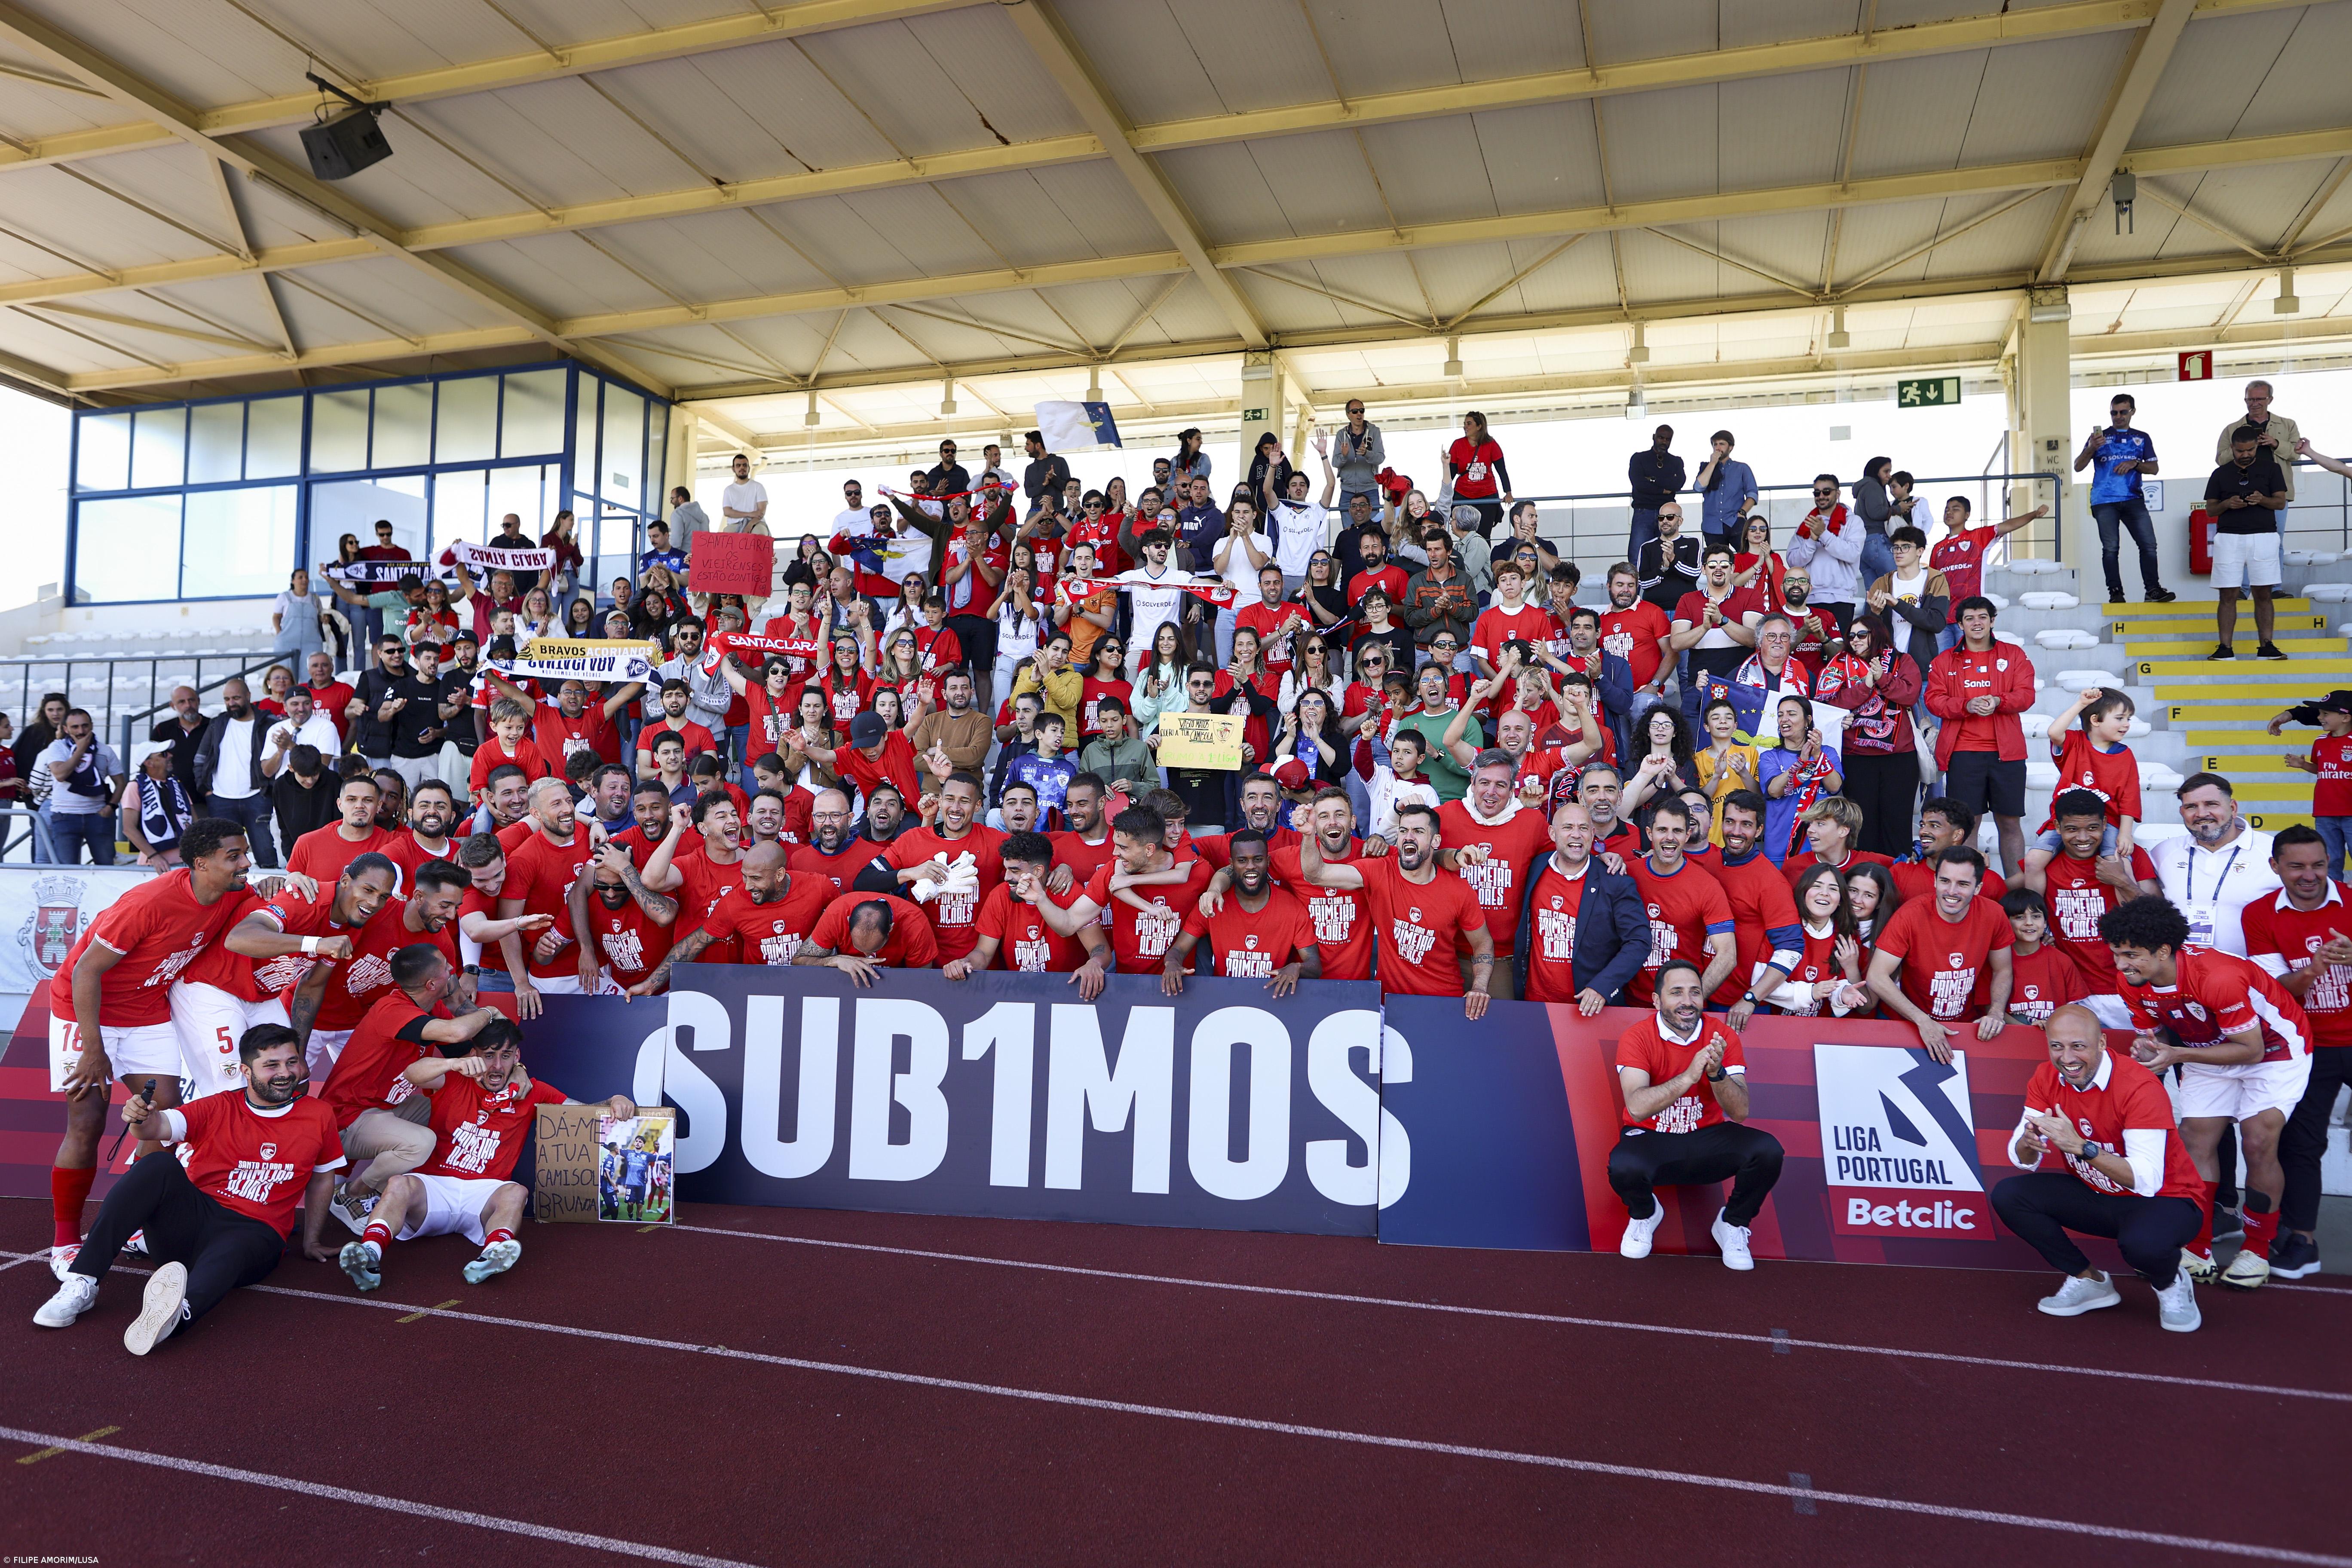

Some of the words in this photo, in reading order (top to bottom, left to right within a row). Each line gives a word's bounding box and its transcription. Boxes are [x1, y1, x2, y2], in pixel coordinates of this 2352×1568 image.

[2047, 456, 2059, 464] WC
[698, 535, 733, 550] SANTA
[739, 538, 770, 554] CLARA
[726, 551, 738, 560] OS
[702, 559, 763, 571] VIEIRENSES
[697, 570, 726, 581] ESTÃO
[728, 573, 767, 583] CONTIGO
[2115, 623, 2125, 633] H
[2314, 619, 2323, 628] H
[728, 635, 818, 651] SANTACLARA
[1603, 637, 1633, 653] PRIMEIRA
[540, 645, 585, 655] BRAVOS
[1268, 647, 1291, 662] AÇORES
[2141, 664, 2150, 674] G
[1964, 679, 1991, 688] Santa
[832, 695, 860, 708] PRIMEIRA
[835, 707, 856, 719] AÇORES
[2172, 708, 2180, 718] F
[1196, 720, 1209, 728] MATOS
[1190, 730, 1213, 740] CAMISOLA
[1165, 753, 1194, 761] RUMO
[1218, 752, 1237, 763] LIGA
[2208, 758, 2217, 769] E
[2252, 816, 2263, 828] D
[1502, 859, 1508, 869] NA
[1460, 865, 1512, 888] PRIMEIRA
[2057, 889, 2071, 898] SANTA
[2072, 888, 2090, 898] CLARA
[2092, 889, 2100, 897] NA
[1309, 903, 1356, 921] PRIMEIRA
[2055, 896, 2105, 917] PRIMEIRA
[940, 904, 973, 924] AÇORES
[1539, 908, 1552, 918] SANTA
[1553, 910, 1568, 920] CLARA
[1136, 919, 1181, 936] PRIMEIRA
[1410, 924, 1425, 935] CLARA
[1650, 920, 1666, 930] CLARA
[2060, 917, 2098, 939] AÇORES
[615, 931, 629, 941] CLARA
[1314, 922, 1351, 941] AÇORES
[603, 936, 643, 957] PRIMEIRA
[761, 937, 777, 946] SANTA
[777, 935, 792, 943] CLARA
[1139, 935, 1174, 956] AÇORES
[363, 953, 381, 965] SANTA
[1228, 950, 1245, 959] SANTA
[1246, 952, 1263, 960] CLARA
[1226, 959, 1273, 978] PRIMEIRA
[2289, 957, 2311, 968] SANTA
[1935, 971, 1951, 980] SANTA
[1952, 969, 1967, 979] CLARA
[1929, 974, 1975, 996] PRIMEIRA
[2316, 983, 2332, 992] PELOS
[2010, 1003, 2025, 1012] SANTA
[2026, 1001, 2045, 1011] CLARA
[2046, 1001, 2054, 1010] NA
[217, 1026, 232, 1054] 5
[632, 989, 1413, 1210] SUB1MOS
[460, 1121, 477, 1133] SANTA
[491, 1130, 500, 1139] NA
[540, 1112, 605, 1144] DÁ-ME
[451, 1127, 500, 1160] PRIMEIRA
[1834, 1126, 1882, 1152] LIGA
[538, 1144, 548, 1163] A
[552, 1143, 590, 1162] TUA
[2103, 1142, 2115, 1152] NA
[238, 1161, 260, 1170] SANTA
[445, 1145, 488, 1174] AÇORES
[1838, 1156, 1953, 1185] PORTUGAL
[1847, 1198, 1976, 1230] Betclic
